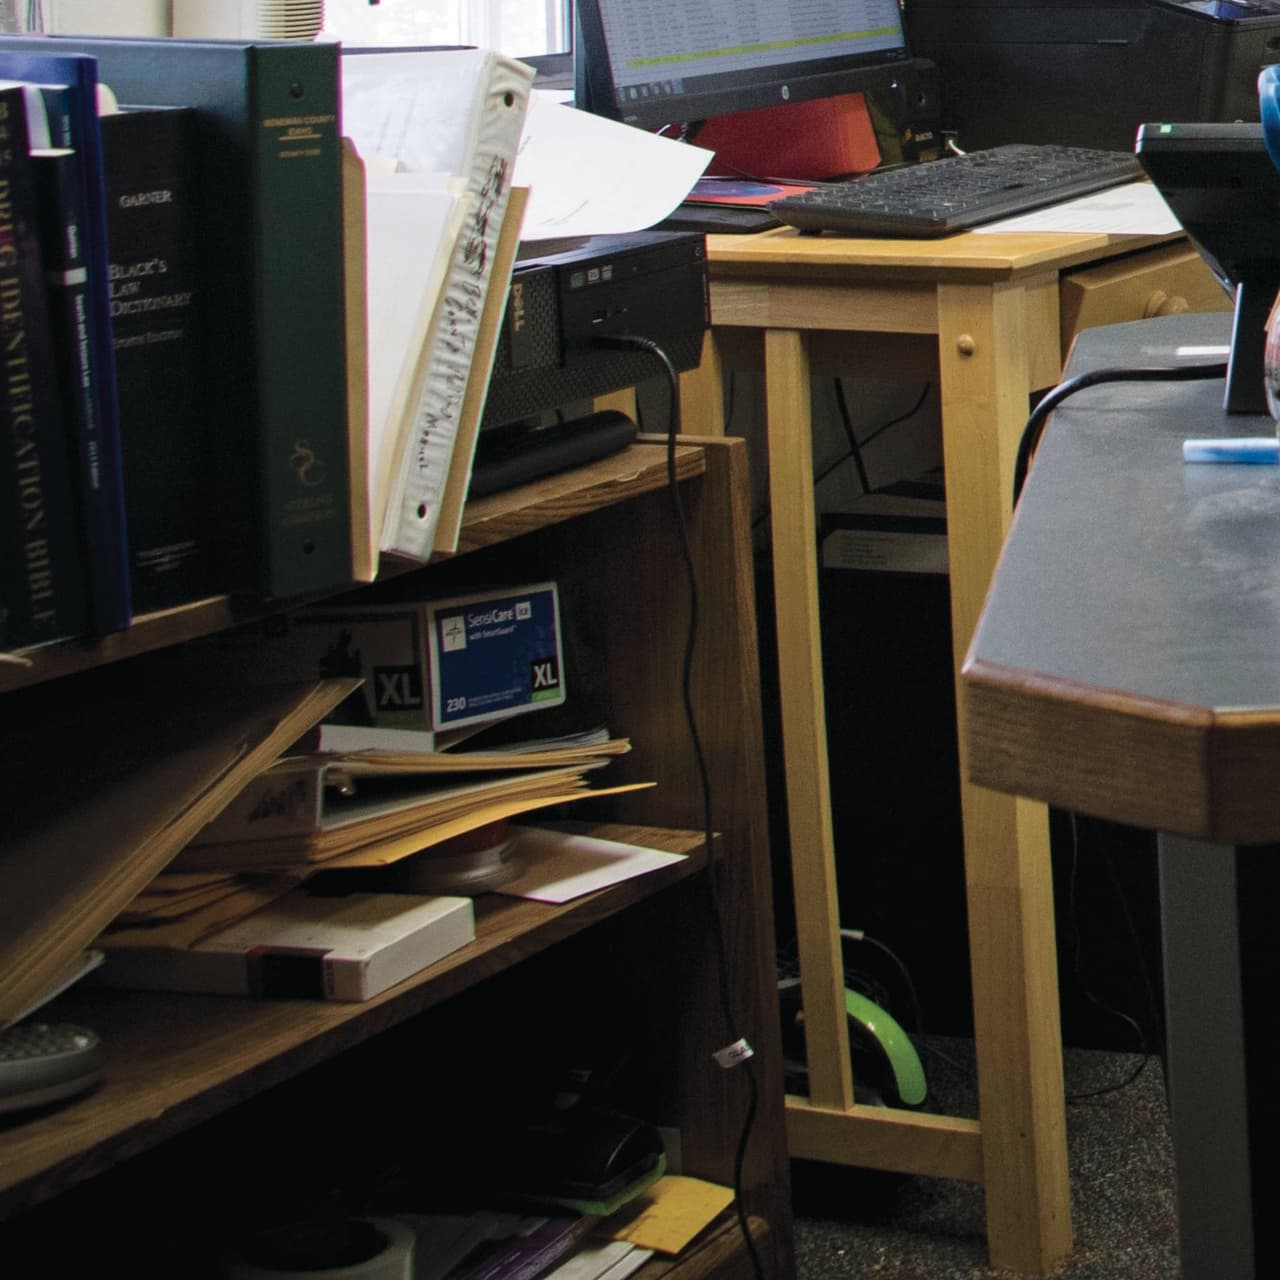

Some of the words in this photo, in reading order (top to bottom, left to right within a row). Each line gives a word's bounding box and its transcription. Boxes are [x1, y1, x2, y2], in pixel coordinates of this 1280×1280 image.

[118, 190, 173, 208] GARNER
[512, 283, 525, 334] DELL
[77, 324, 89, 338] and
[2, 277, 50, 530] IDENTIFICATION
[24, 539, 58, 627] BIBLE
[466, 604, 514, 628] SensiCare
[379, 673, 421, 705] XL
[533, 662, 558, 689] XL
[446, 696, 466, 713] 230
